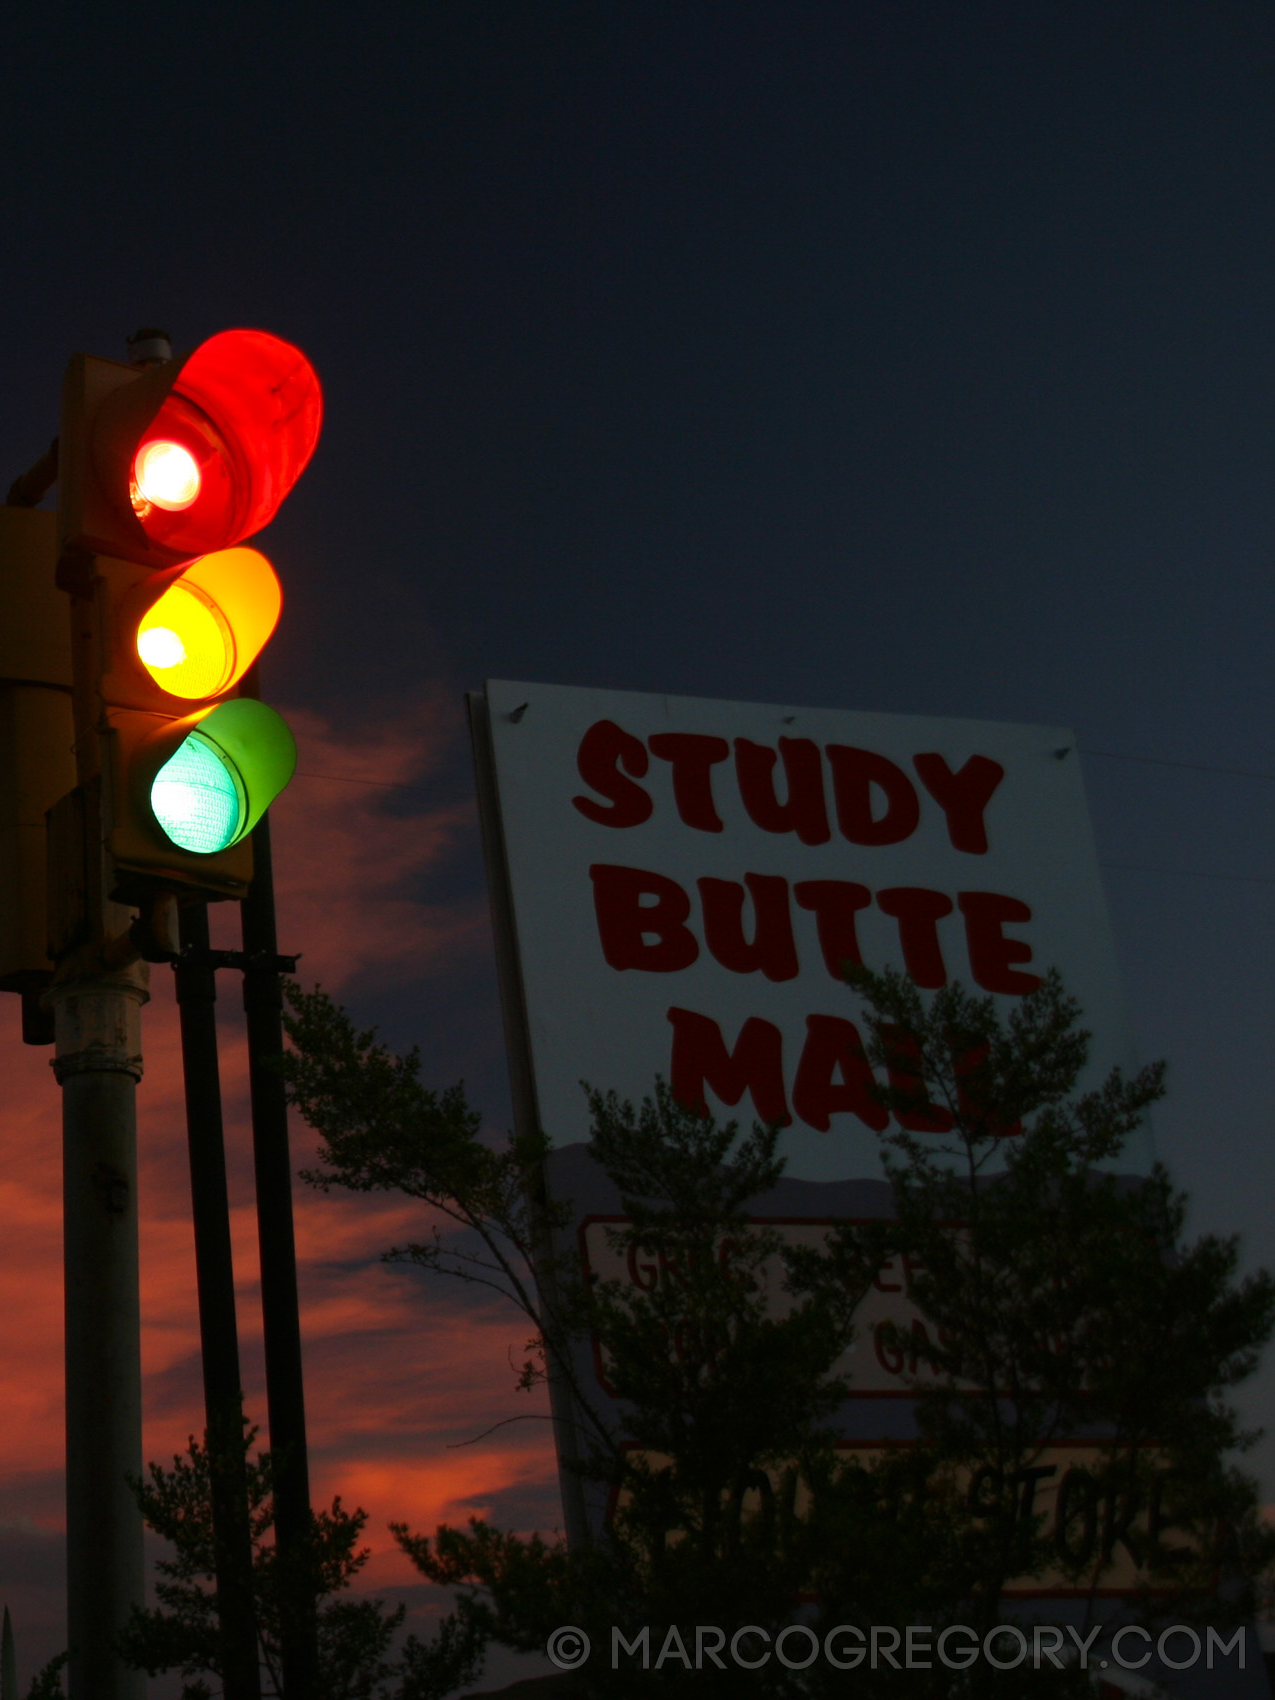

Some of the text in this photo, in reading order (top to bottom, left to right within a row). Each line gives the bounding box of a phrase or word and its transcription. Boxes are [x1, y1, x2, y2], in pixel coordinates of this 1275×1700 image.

[572, 719, 1004, 854] STUDY
[589, 863, 1041, 995] BUTTE
[667, 1006, 1023, 1137] MALL
